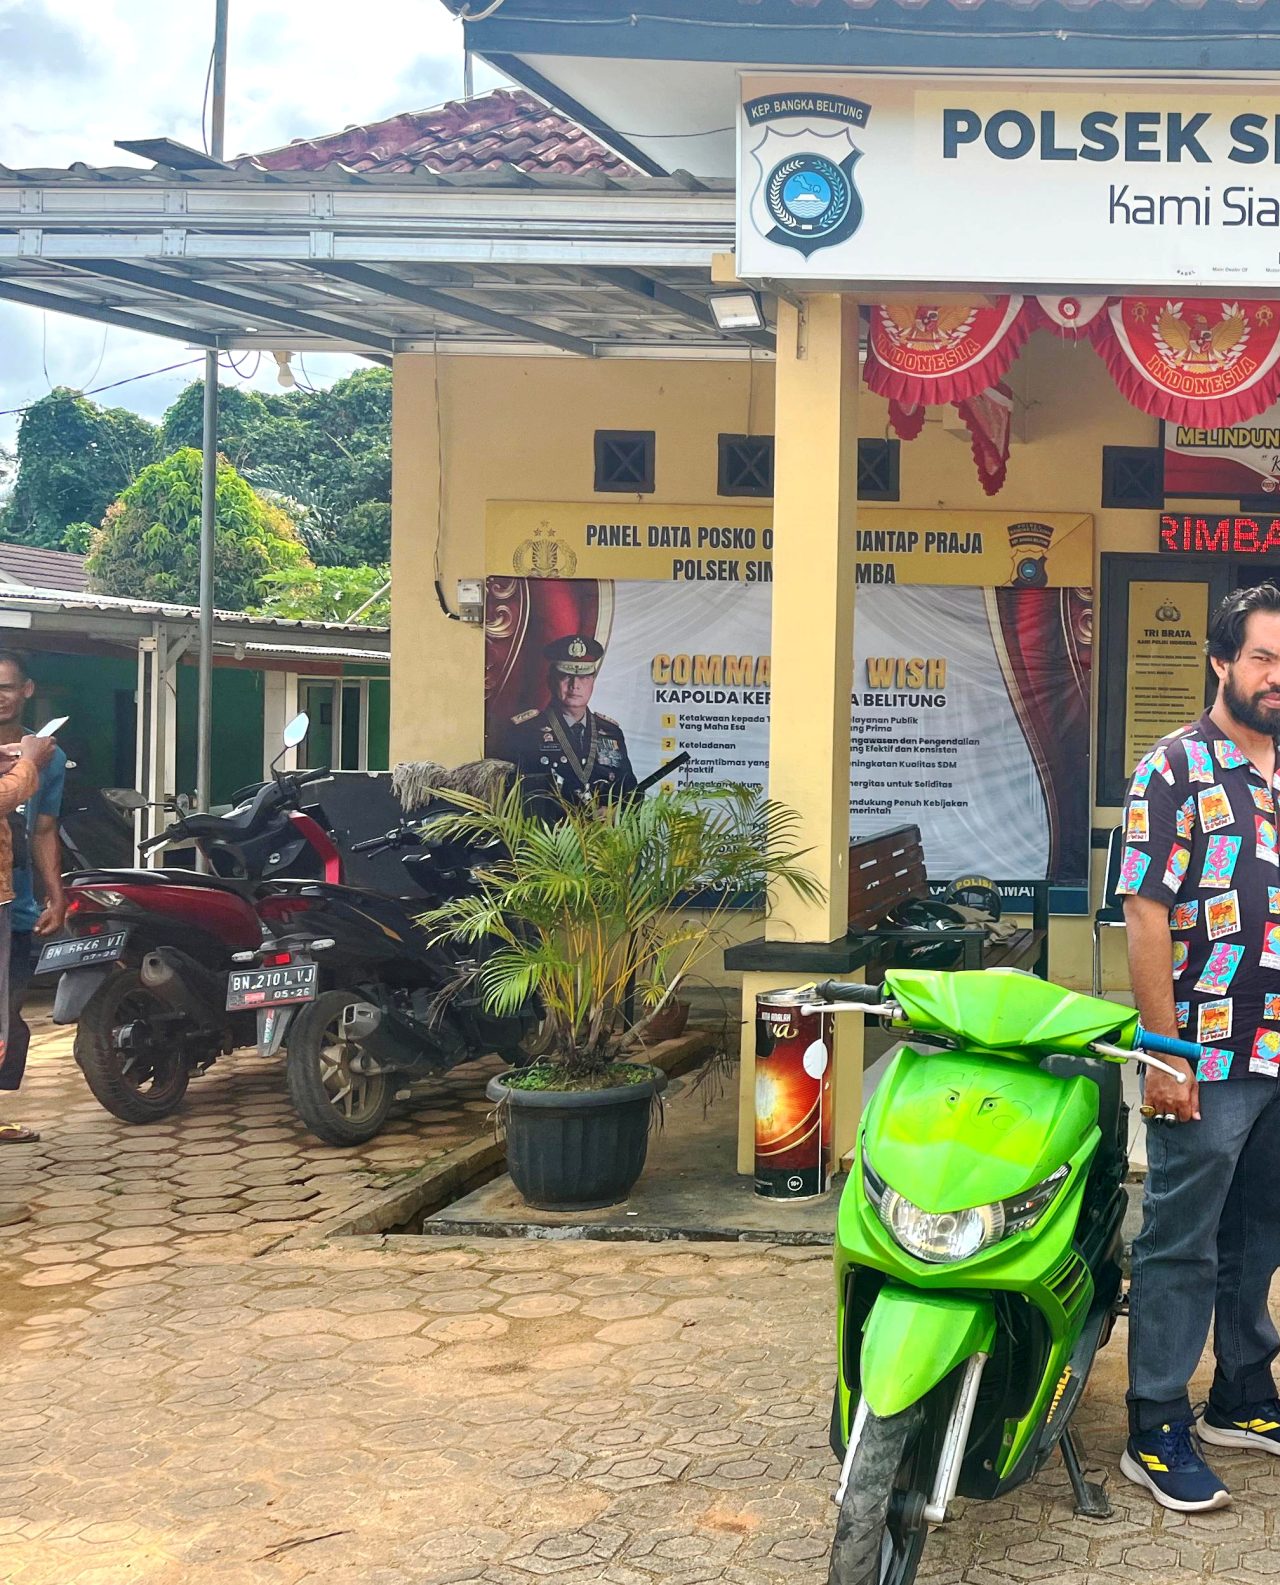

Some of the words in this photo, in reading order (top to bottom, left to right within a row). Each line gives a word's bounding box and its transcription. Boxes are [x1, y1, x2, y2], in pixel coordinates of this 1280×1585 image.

[751, 103, 772, 118] KEP.
[773, 99, 814, 113] BANGKA
[816, 100, 863, 119] BELITUNG
[942, 109, 1213, 164] POLSEK
[1109, 184, 1210, 226] Kami
[877, 333, 981, 372] INDONESIA
[1146, 354, 1258, 394] INDONESIA
[586, 524, 641, 547] PANEL
[648, 526, 691, 548] DATA
[698, 527, 755, 549] POSKO
[856, 530, 918, 553] ANTAP
[925, 532, 982, 554] PRAJA
[673, 559, 739, 581] POLSEK
[855, 563, 896, 584] MBA
[1144, 629, 1159, 637] TRI
[1161, 629, 1192, 638] BRATA
[651, 654, 771, 687] COMMA
[865, 657, 947, 689] WISH
[656, 690, 739, 704] KAPOLDA
[864, 694, 947, 707] BELITUNG
[679, 714, 730, 722] Ketakwaan
[732, 715, 765, 724] kepada
[851, 716, 889, 724] layanan
[890, 717, 918, 725] Publik
[679, 723, 702, 731] Yang
[704, 723, 729, 731] Maha
[731, 723, 746, 731] Esa
[679, 742, 736, 750] Keteladanan
[851, 737, 899, 746] ngawasan
[919, 738, 980, 747] Pengendalian
[866, 745, 893, 753] Efektif
[914, 746, 957, 754] Konsisten
[850, 760, 897, 769] ningkatan
[899, 760, 936, 768] Kualitas
[850, 780, 885, 789] nergitas
[914, 780, 953, 788] Soliditas
[849, 799, 893, 808] ndukung
[894, 799, 922, 807] Penuh
[923, 799, 968, 809] Kebijakan
[955, 878, 993, 890] POLISI
[233, 975, 250, 991] BN
[297, 969, 312, 982] VJ
